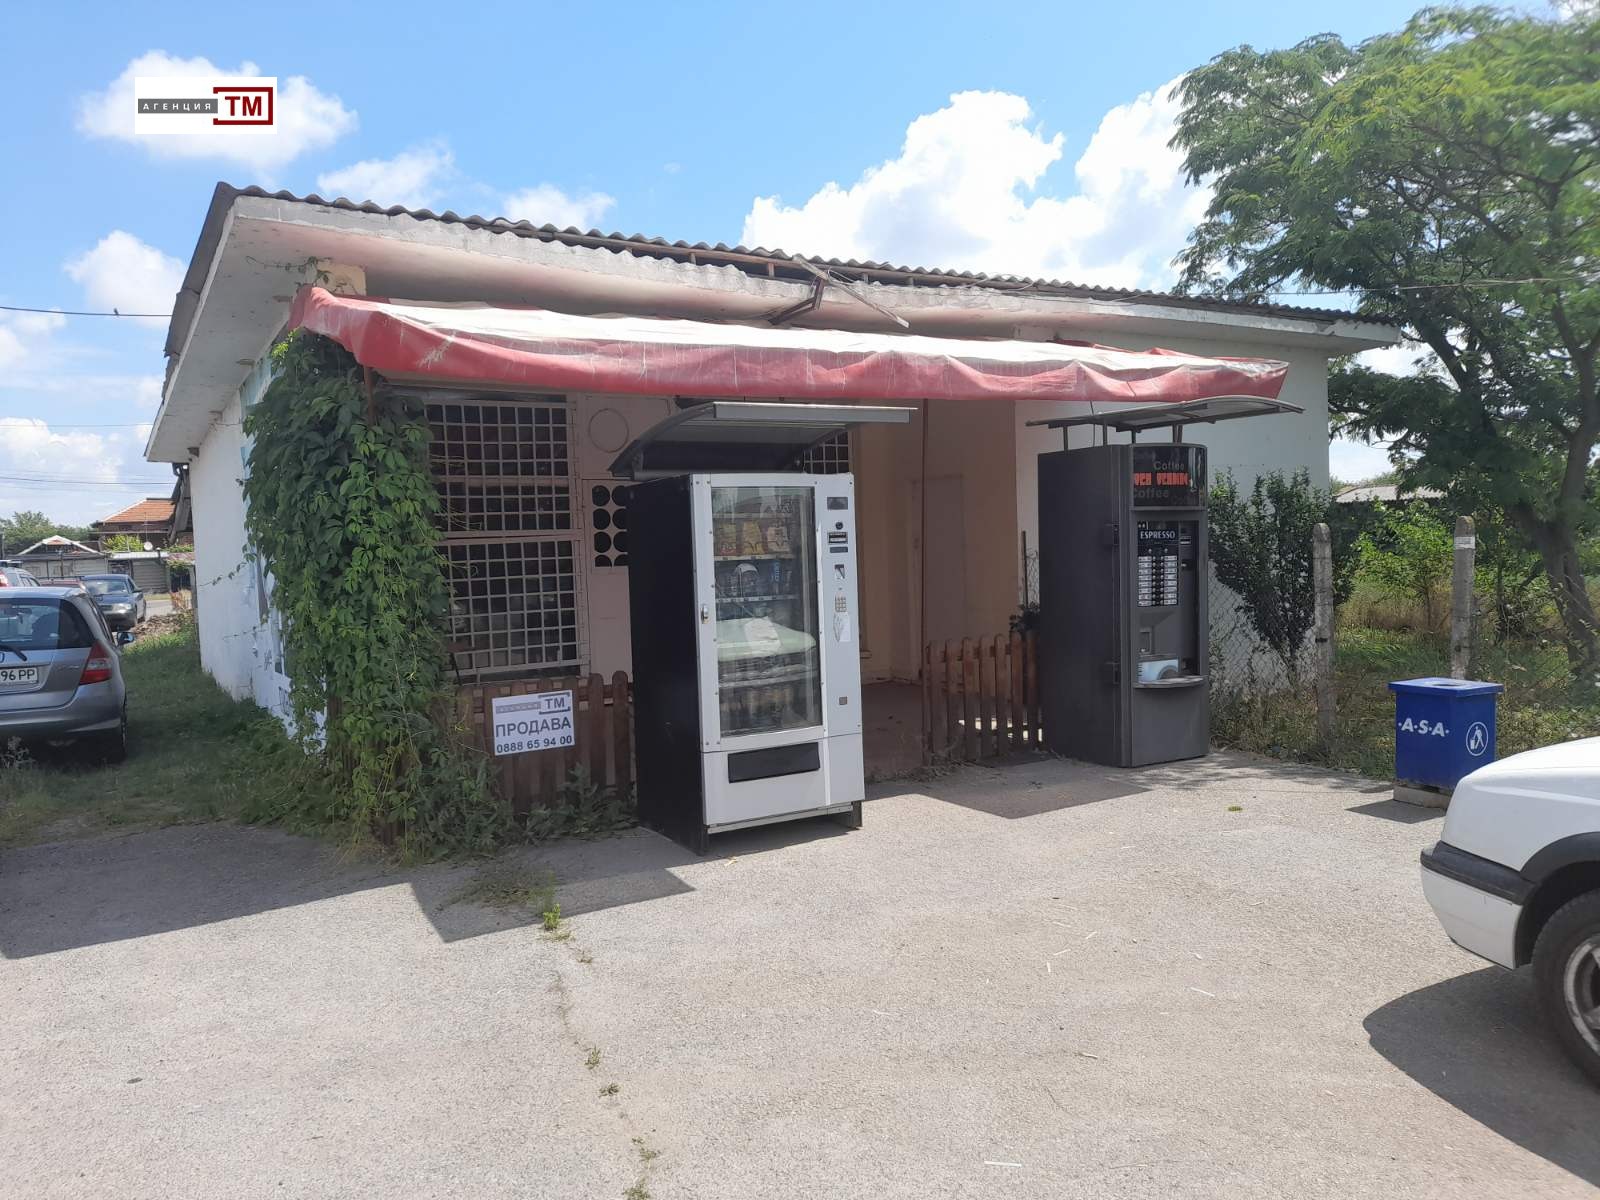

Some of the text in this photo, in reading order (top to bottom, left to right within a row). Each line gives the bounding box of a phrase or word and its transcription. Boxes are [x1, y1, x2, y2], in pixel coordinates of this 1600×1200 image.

[1140, 530, 1176, 540] ESPRESSO
[1, 669, 35, 681] 96 PP
[495, 716, 572, 738] ПРОДАВА
[496, 735, 572, 753] 0888 65 94 00
